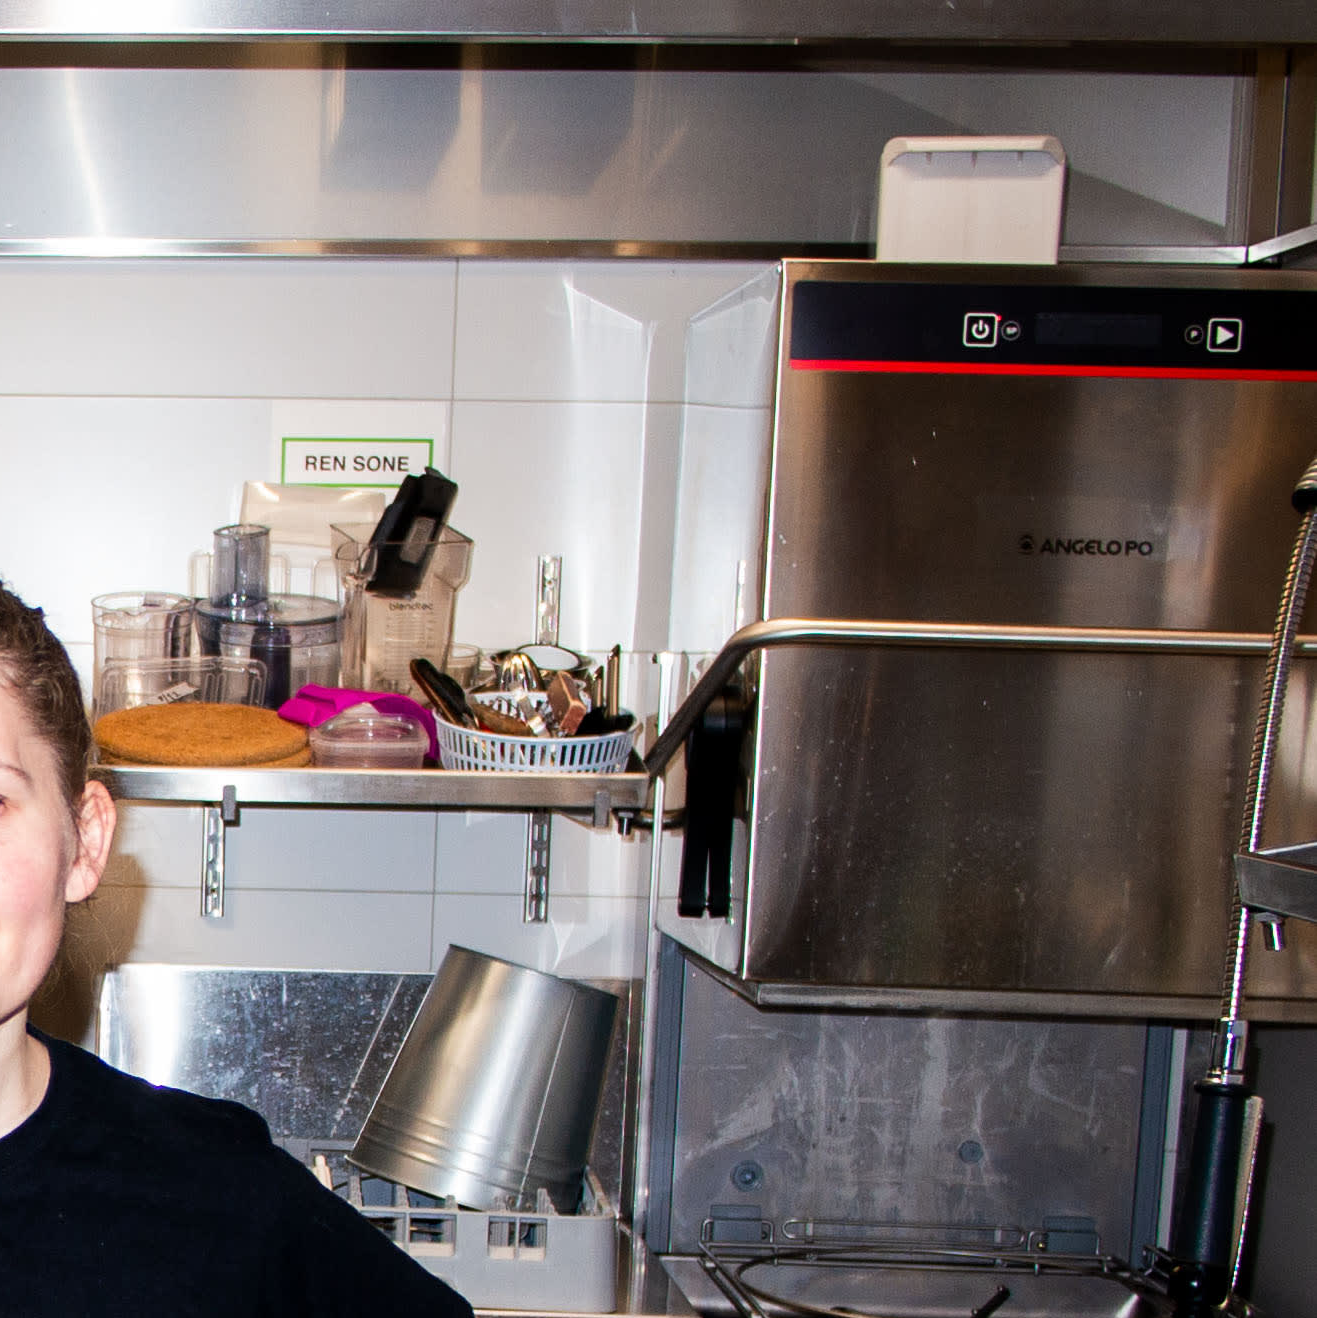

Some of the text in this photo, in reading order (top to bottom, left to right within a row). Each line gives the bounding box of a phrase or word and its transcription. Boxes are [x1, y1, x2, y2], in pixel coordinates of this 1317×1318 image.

[305, 455, 409, 472] REN SONE
[1042, 539, 1153, 556] ANGELO PO
